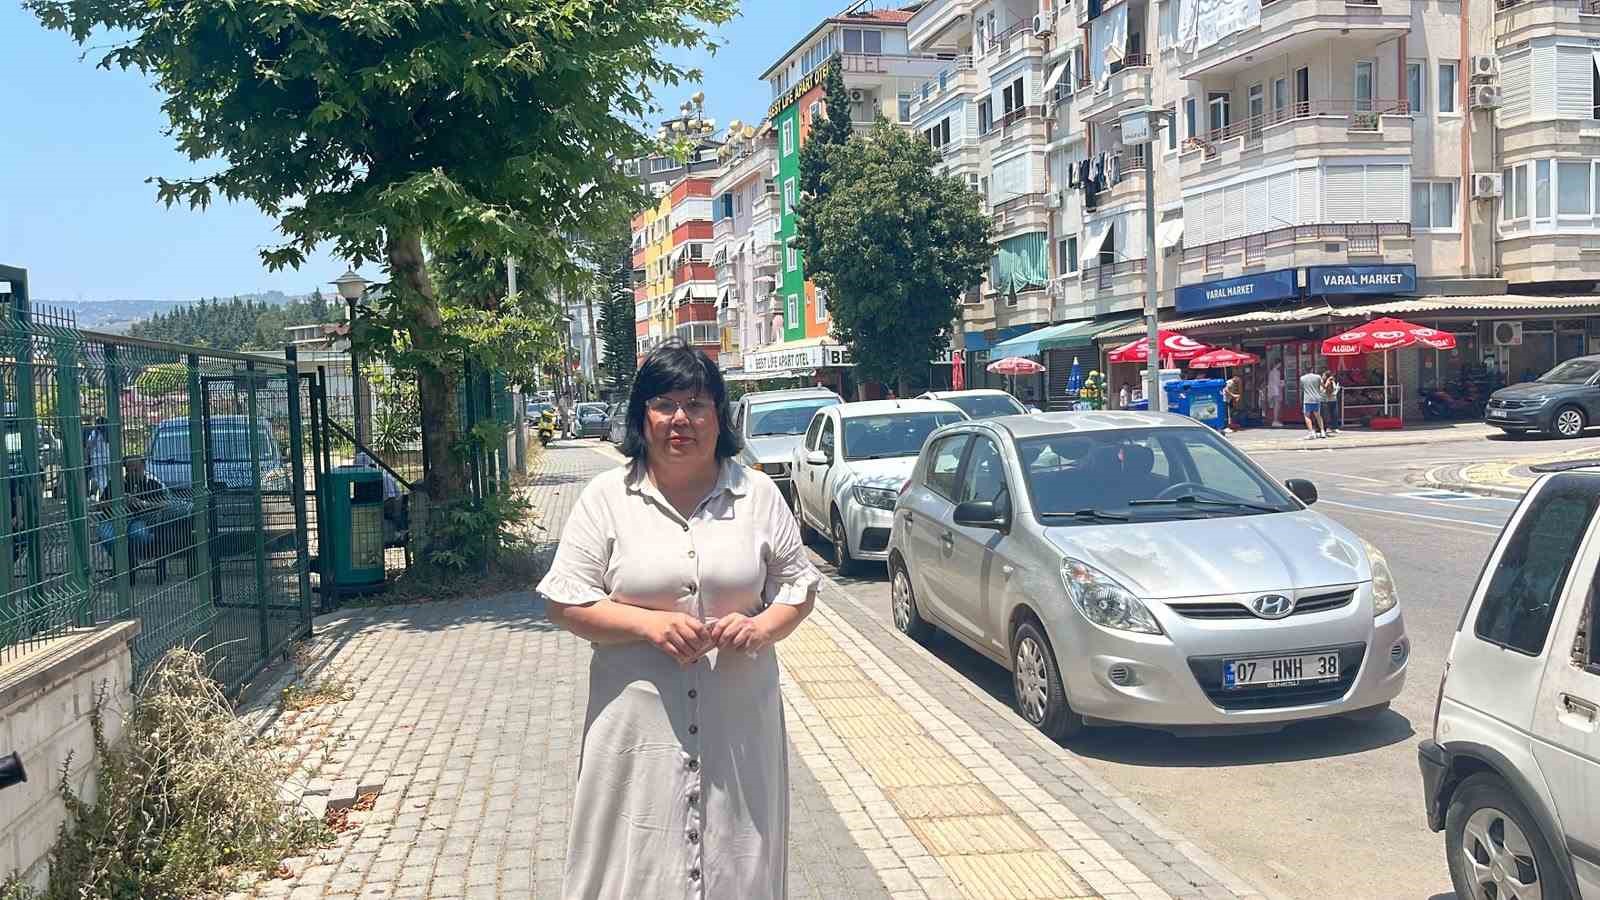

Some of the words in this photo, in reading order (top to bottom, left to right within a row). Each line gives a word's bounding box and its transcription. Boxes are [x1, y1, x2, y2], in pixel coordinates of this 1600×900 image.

[781, 93, 794, 109] LIFE
[795, 76, 814, 100] APART
[1323, 274, 1358, 286] VARAL
[1360, 273, 1403, 285] MARKET
[1206, 287, 1227, 300] VARAL
[1228, 284, 1254, 296] MARKET
[755, 357, 767, 369] BEST
[768, 356, 778, 368] LIFE
[778, 353, 794, 367] APART
[795, 352, 809, 366] OTEL
[1237, 662, 1257, 682] 07
[1273, 657, 1303, 680] HNH
[1318, 655, 1338, 675] 38
